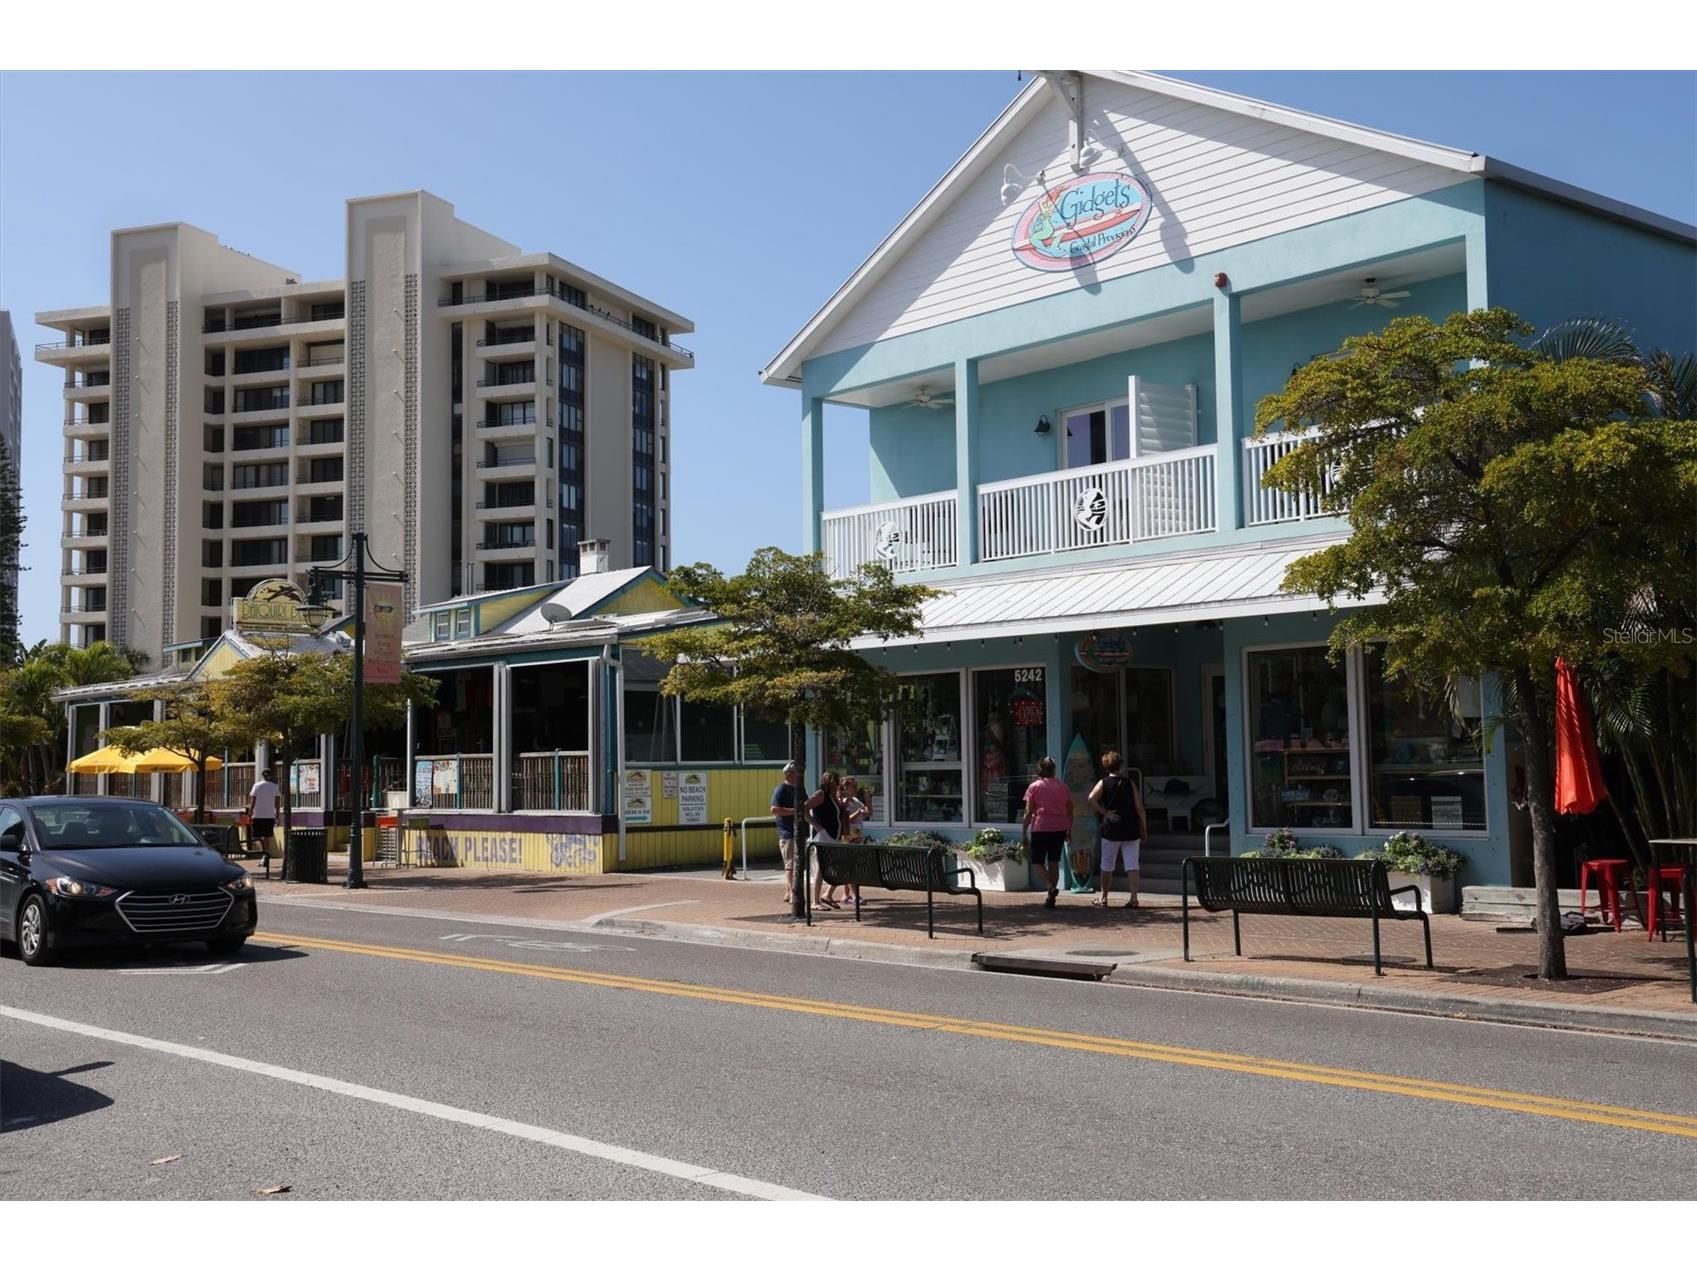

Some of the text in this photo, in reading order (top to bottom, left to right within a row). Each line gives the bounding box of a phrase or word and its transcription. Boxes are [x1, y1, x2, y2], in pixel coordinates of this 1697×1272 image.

[1014, 668, 1042, 683] 5242
[688, 786, 706, 794] BEACH
[681, 795, 705, 803] PARKING
[464, 837, 522, 864] PLEASE!
